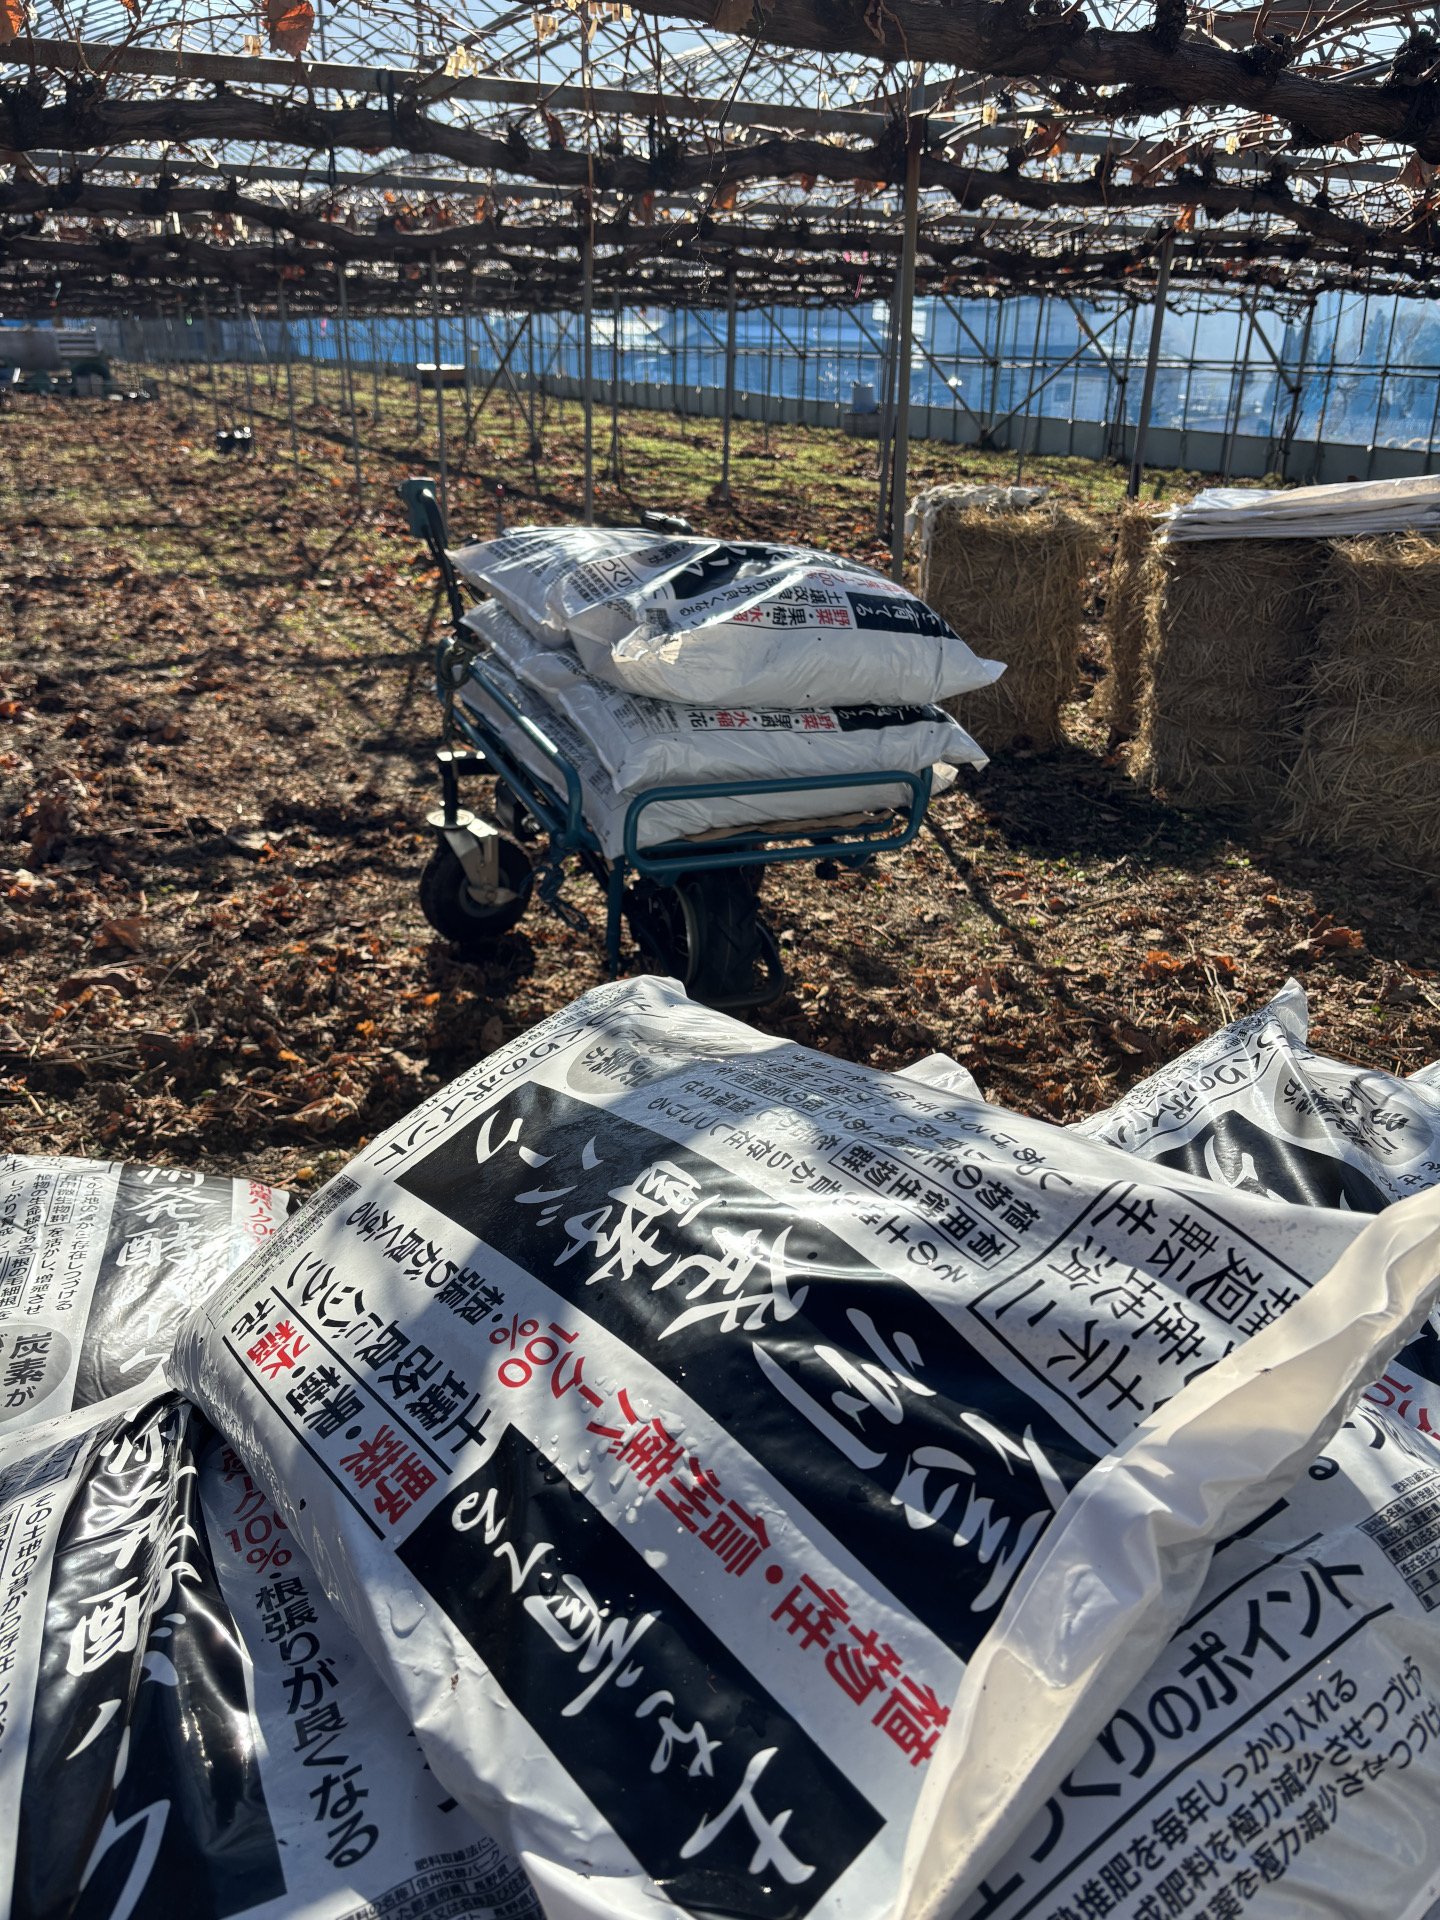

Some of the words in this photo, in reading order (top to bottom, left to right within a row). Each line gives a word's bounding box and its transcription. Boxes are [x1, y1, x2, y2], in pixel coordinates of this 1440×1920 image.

[3, 1331, 53, 1409] 炭素が
[286, 1251, 493, 1455] 土壌改良にバツグン
[995, 1279, 1174, 1426] 土不二
[1047, 1235, 1235, 1385] 産地消
[230, 1296, 439, 1525] 野菜・果樹・水稲・花
[451, 1488, 816, 1884] 土を育てる
